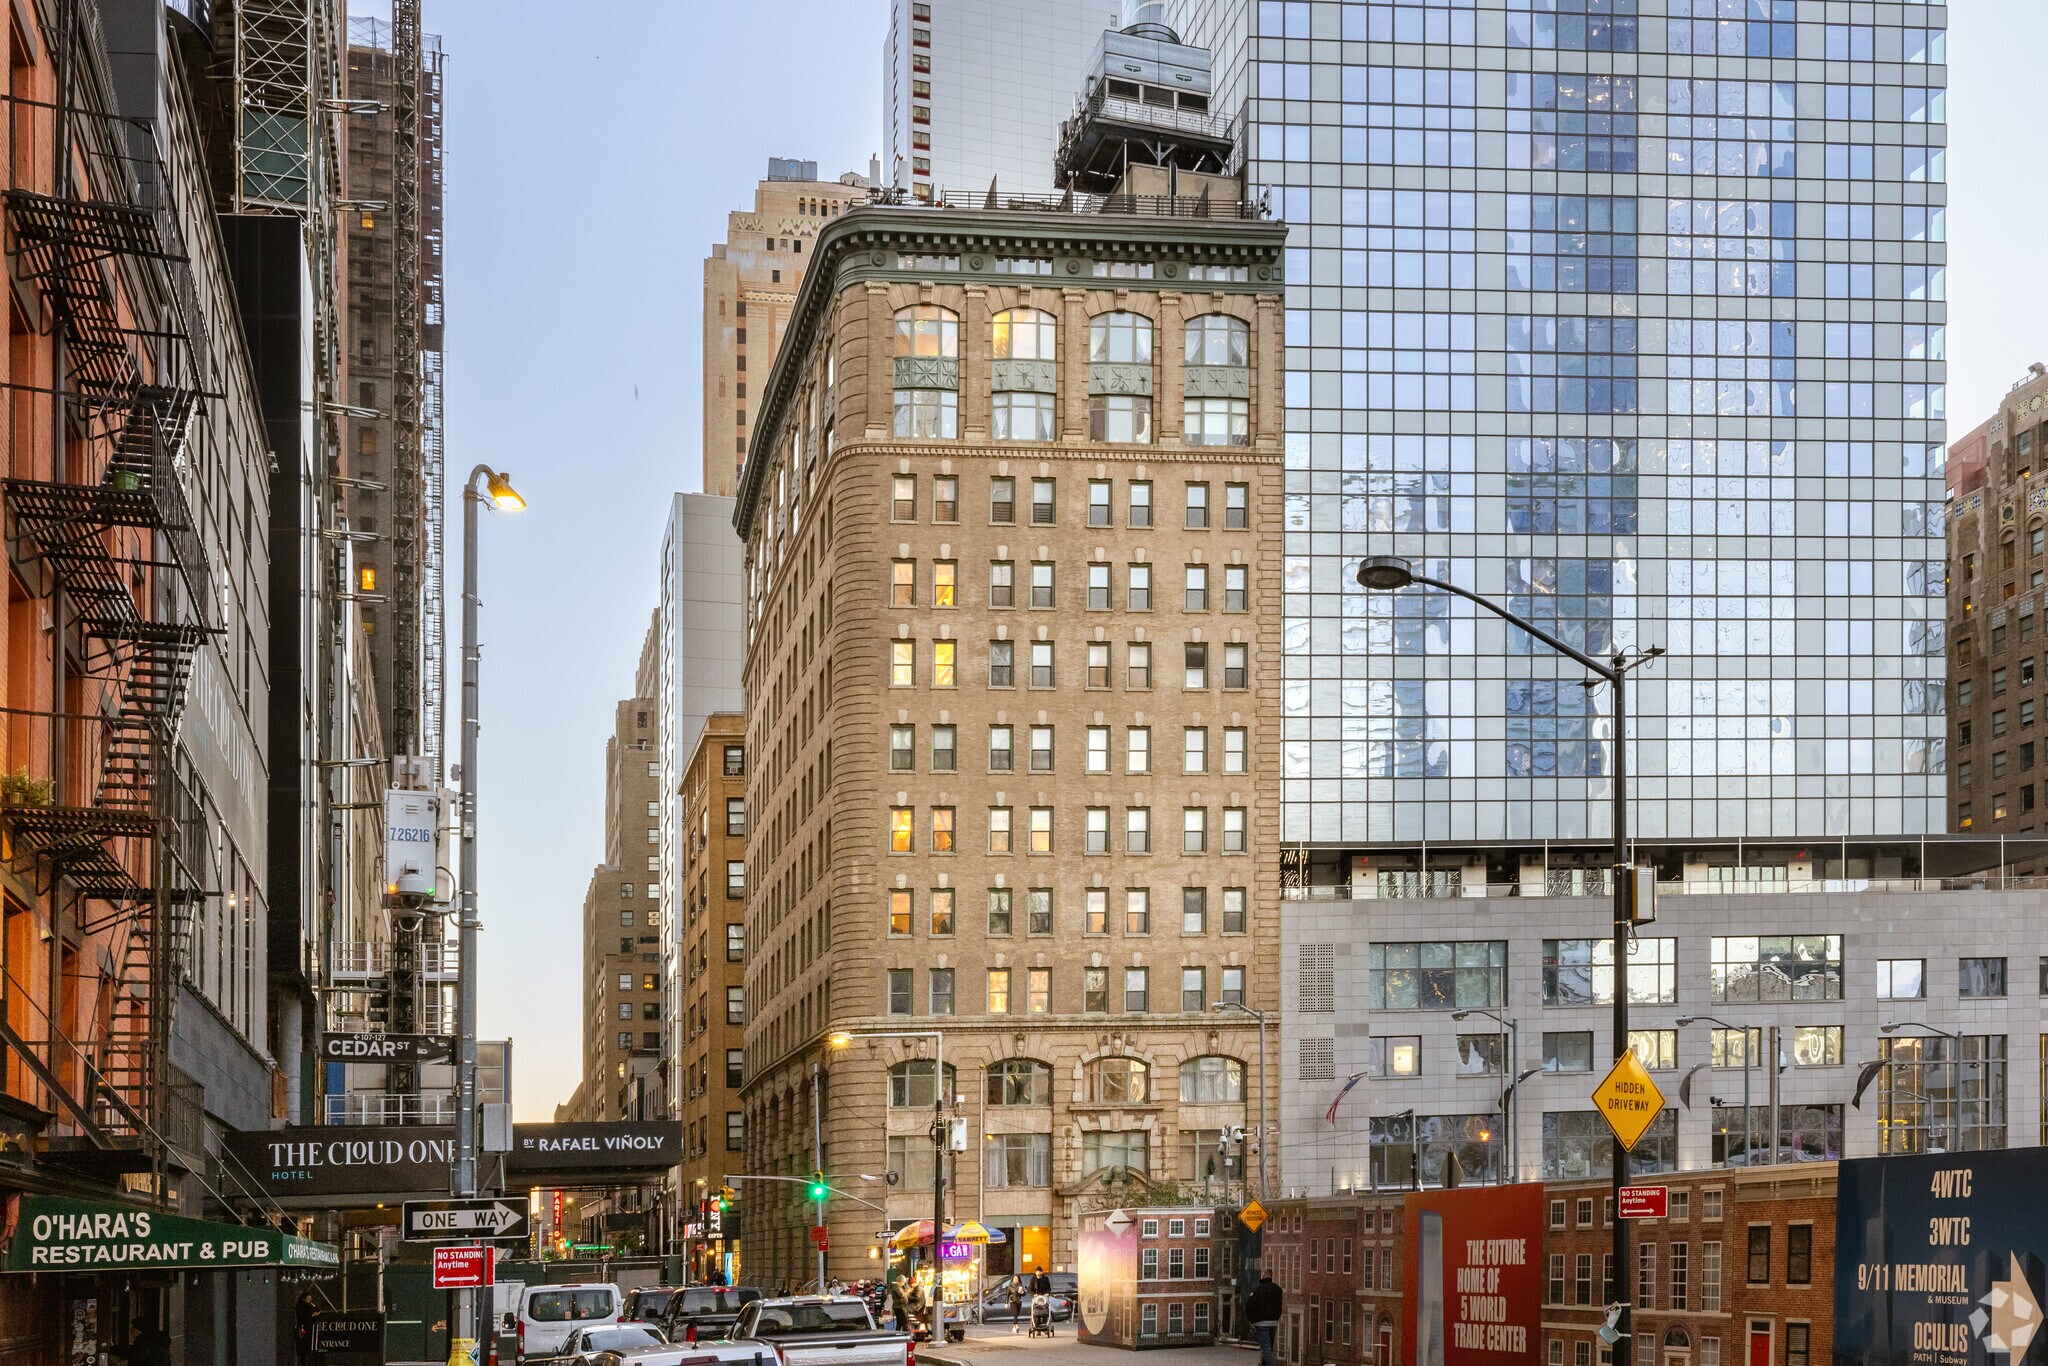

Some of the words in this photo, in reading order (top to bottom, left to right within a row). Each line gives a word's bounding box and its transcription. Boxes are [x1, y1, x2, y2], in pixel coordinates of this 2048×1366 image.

[328, 1040, 395, 1057] CEDAR
[397, 1041, 410, 1050] ST
[1615, 1081, 1645, 1095] HIDDEN
[1608, 1098, 1650, 1112] DRIVEWAY
[523, 1138, 534, 1148] BY
[539, 1138, 600, 1151] RAFAEL
[604, 1134, 664, 1149] VIÑOLY
[268, 1142, 324, 1167] THE
[327, 1140, 404, 1165] CLOUD
[271, 1171, 314, 1180] HOTEL
[1930, 1168, 1973, 1199] 4WTC
[32, 1211, 151, 1241] O'HARA'S
[422, 1212, 457, 1229] ONE
[474, 1210, 510, 1226] WAY
[1929, 1216, 1971, 1246] 3WTC
[32, 1243, 194, 1265] RESTAURANT
[199, 1242, 216, 1260] &
[222, 1240, 270, 1259] PUB
[437, 1251, 448, 1260] NO
[1466, 1240, 1485, 1266] THE
[1486, 1238, 1526, 1266] FUTURE
[437, 1260, 469, 1270] Anytime
[1457, 1267, 1485, 1293] HOME
[1487, 1267, 1500, 1294] OF
[1858, 1263, 1889, 1291] 9/11
[1895, 1264, 1969, 1293] MEMORIAL
[1461, 1295, 1468, 1321] 5
[1469, 1295, 1507, 1322] WORLD
[1927, 1295, 1934, 1304] &
[1935, 1296, 1969, 1305] MUSEUM
[328, 1321, 357, 1332] CLOUD
[357, 1321, 378, 1331] ONE
[320, 1340, 351, 1348] NTRANCE
[1454, 1322, 1485, 1350] TRADE
[1487, 1324, 1527, 1353] CENTER
[1914, 1321, 1969, 1353] OCULUS
[1913, 1352, 1932, 1362] PATH
[1939, 1354, 1968, 1366] Subway
